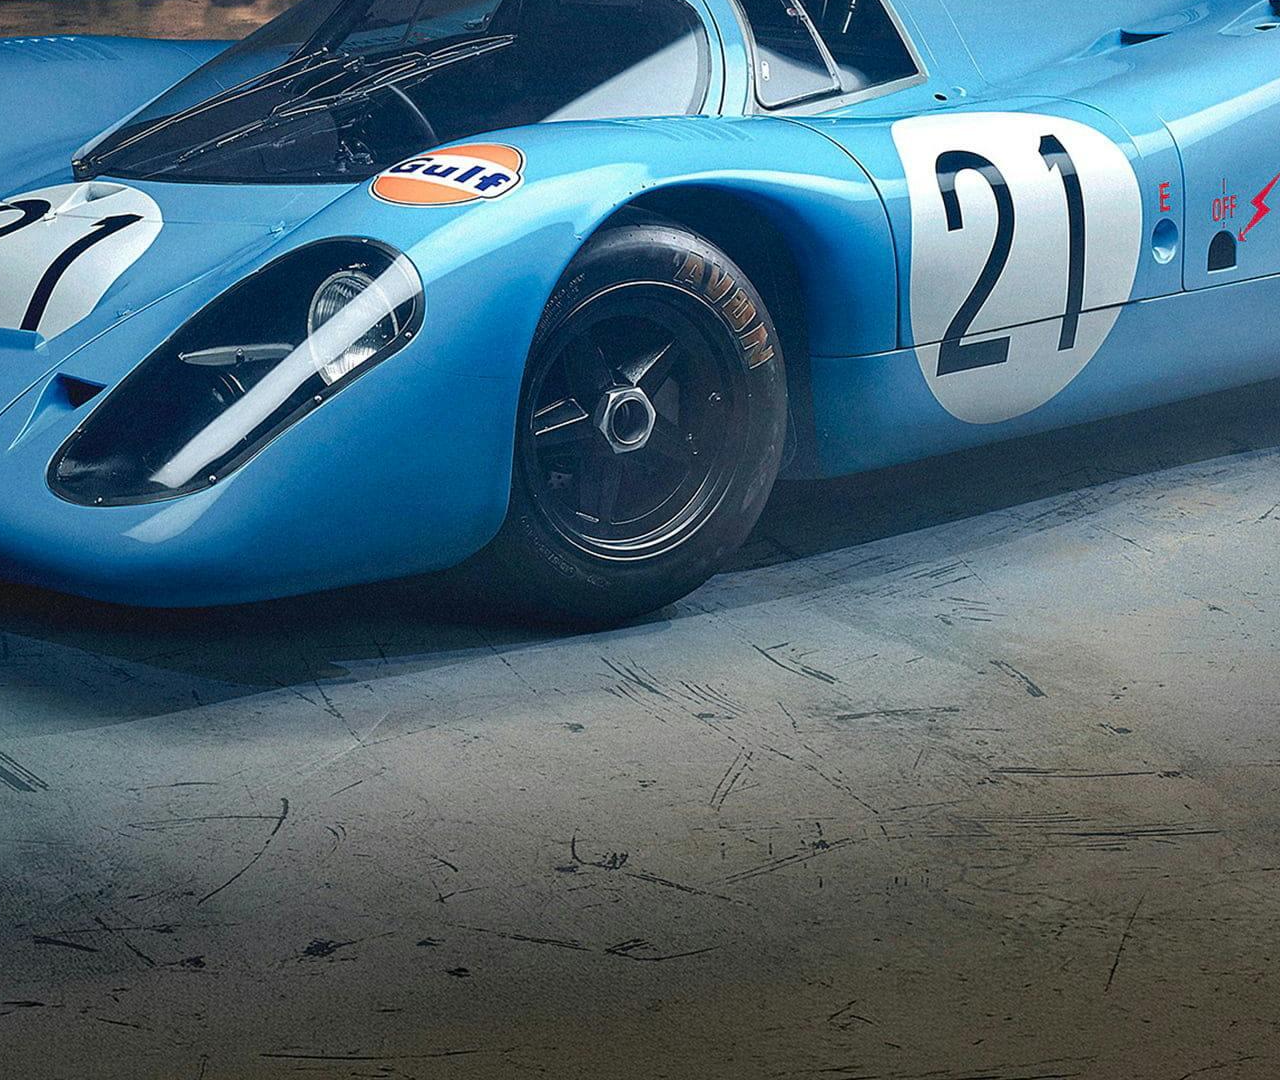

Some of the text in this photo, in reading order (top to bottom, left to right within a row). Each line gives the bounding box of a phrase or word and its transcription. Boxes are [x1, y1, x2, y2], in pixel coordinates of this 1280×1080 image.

[389, 157, 511, 192] Gulf
[1158, 181, 1171, 212] E
[1211, 194, 1238, 222] OFF
[934, 133, 1087, 378] 21
[674, 251, 775, 370] AVON
